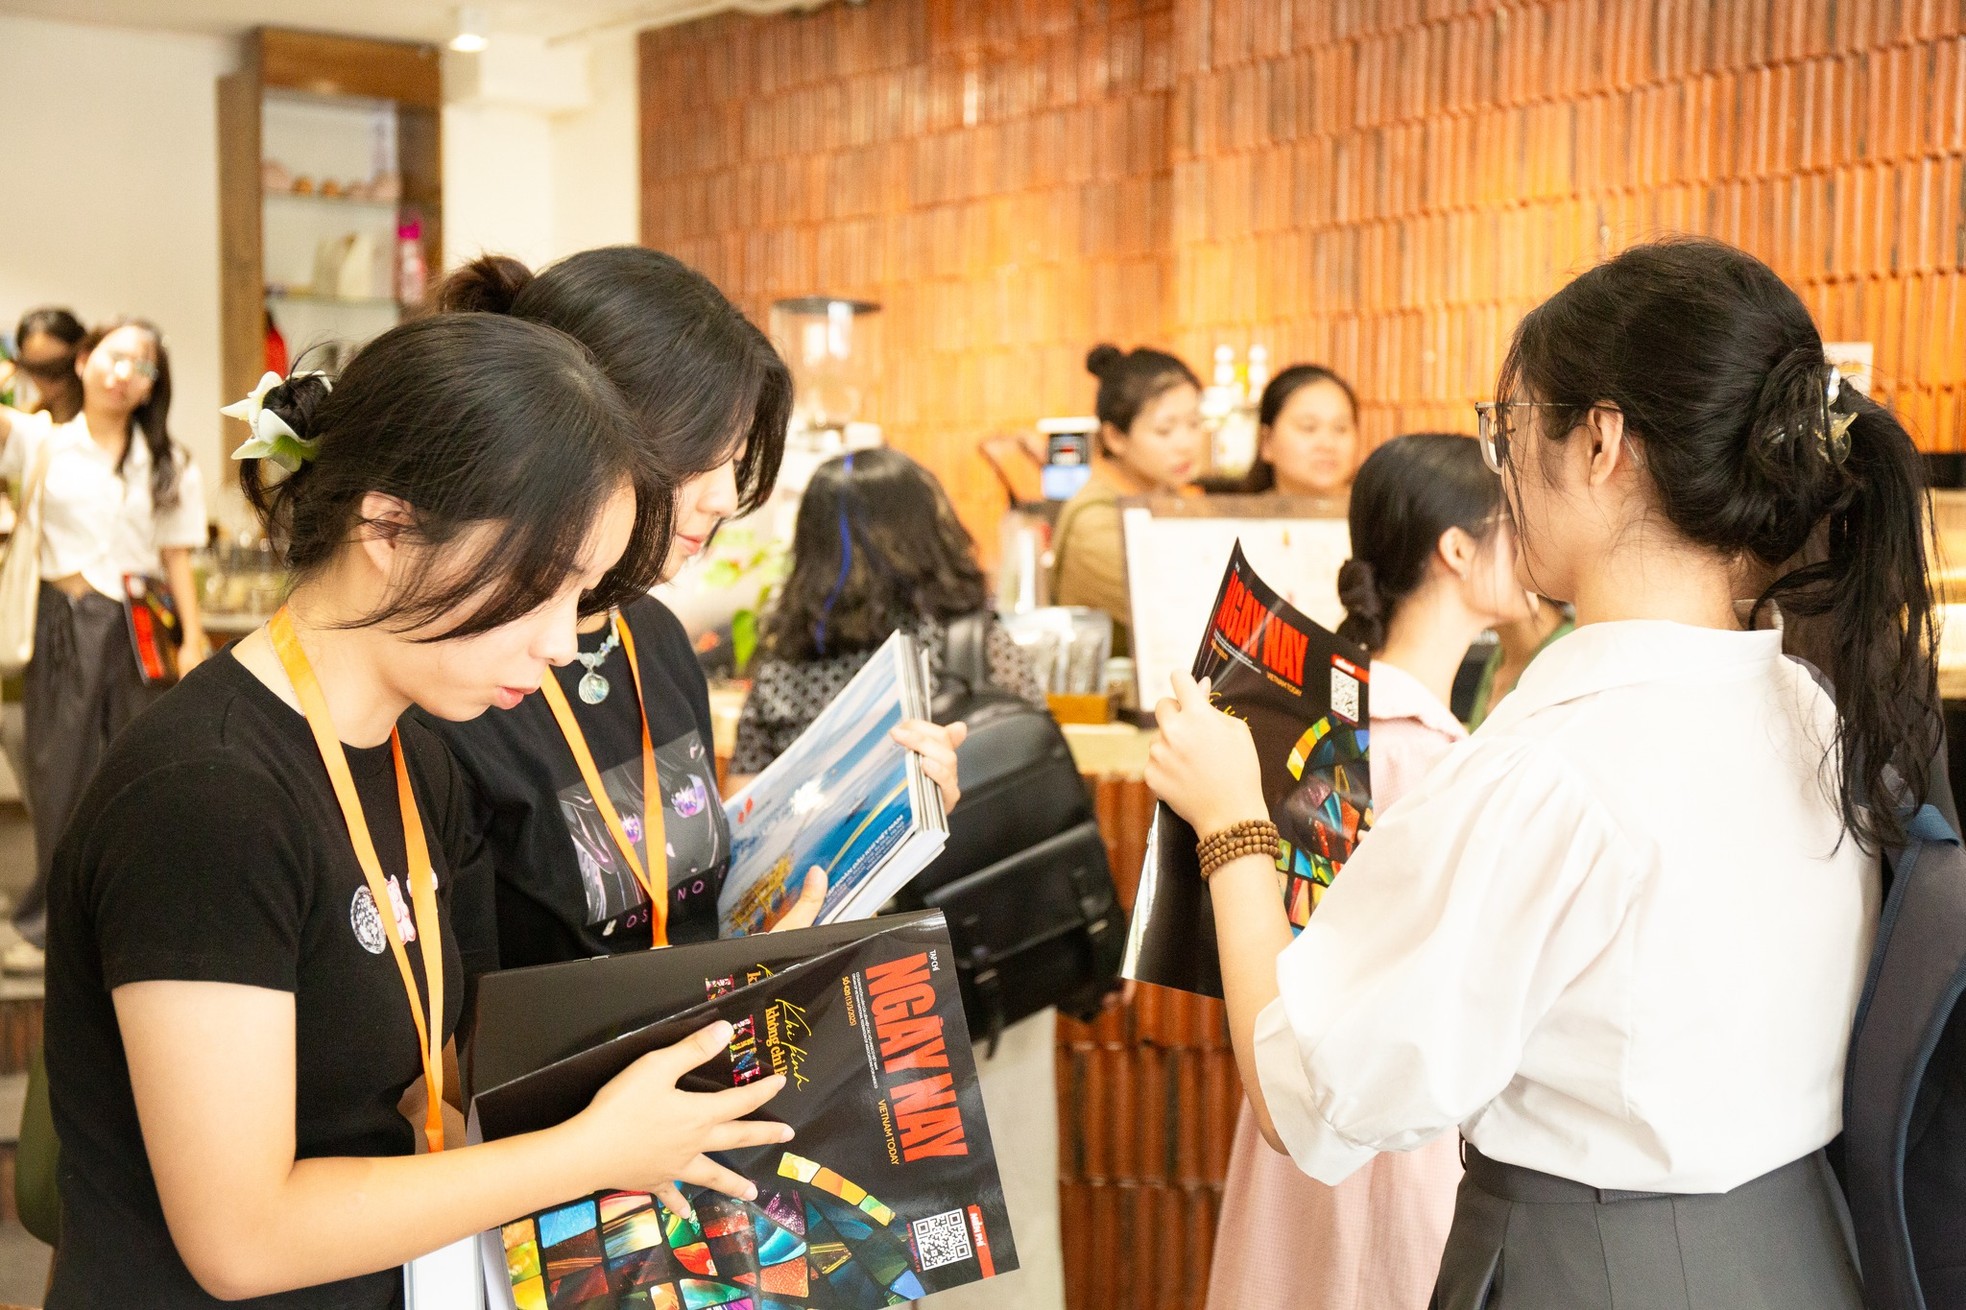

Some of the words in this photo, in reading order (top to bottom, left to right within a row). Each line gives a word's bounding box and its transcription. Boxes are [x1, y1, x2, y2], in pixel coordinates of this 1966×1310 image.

[1262, 610, 1309, 687] NAY
[866, 952, 949, 1074] NGÀY
[878, 1099, 892, 1137] VIETNAM
[886, 1136, 899, 1165] TODAY
[890, 1072, 969, 1163] NAY
